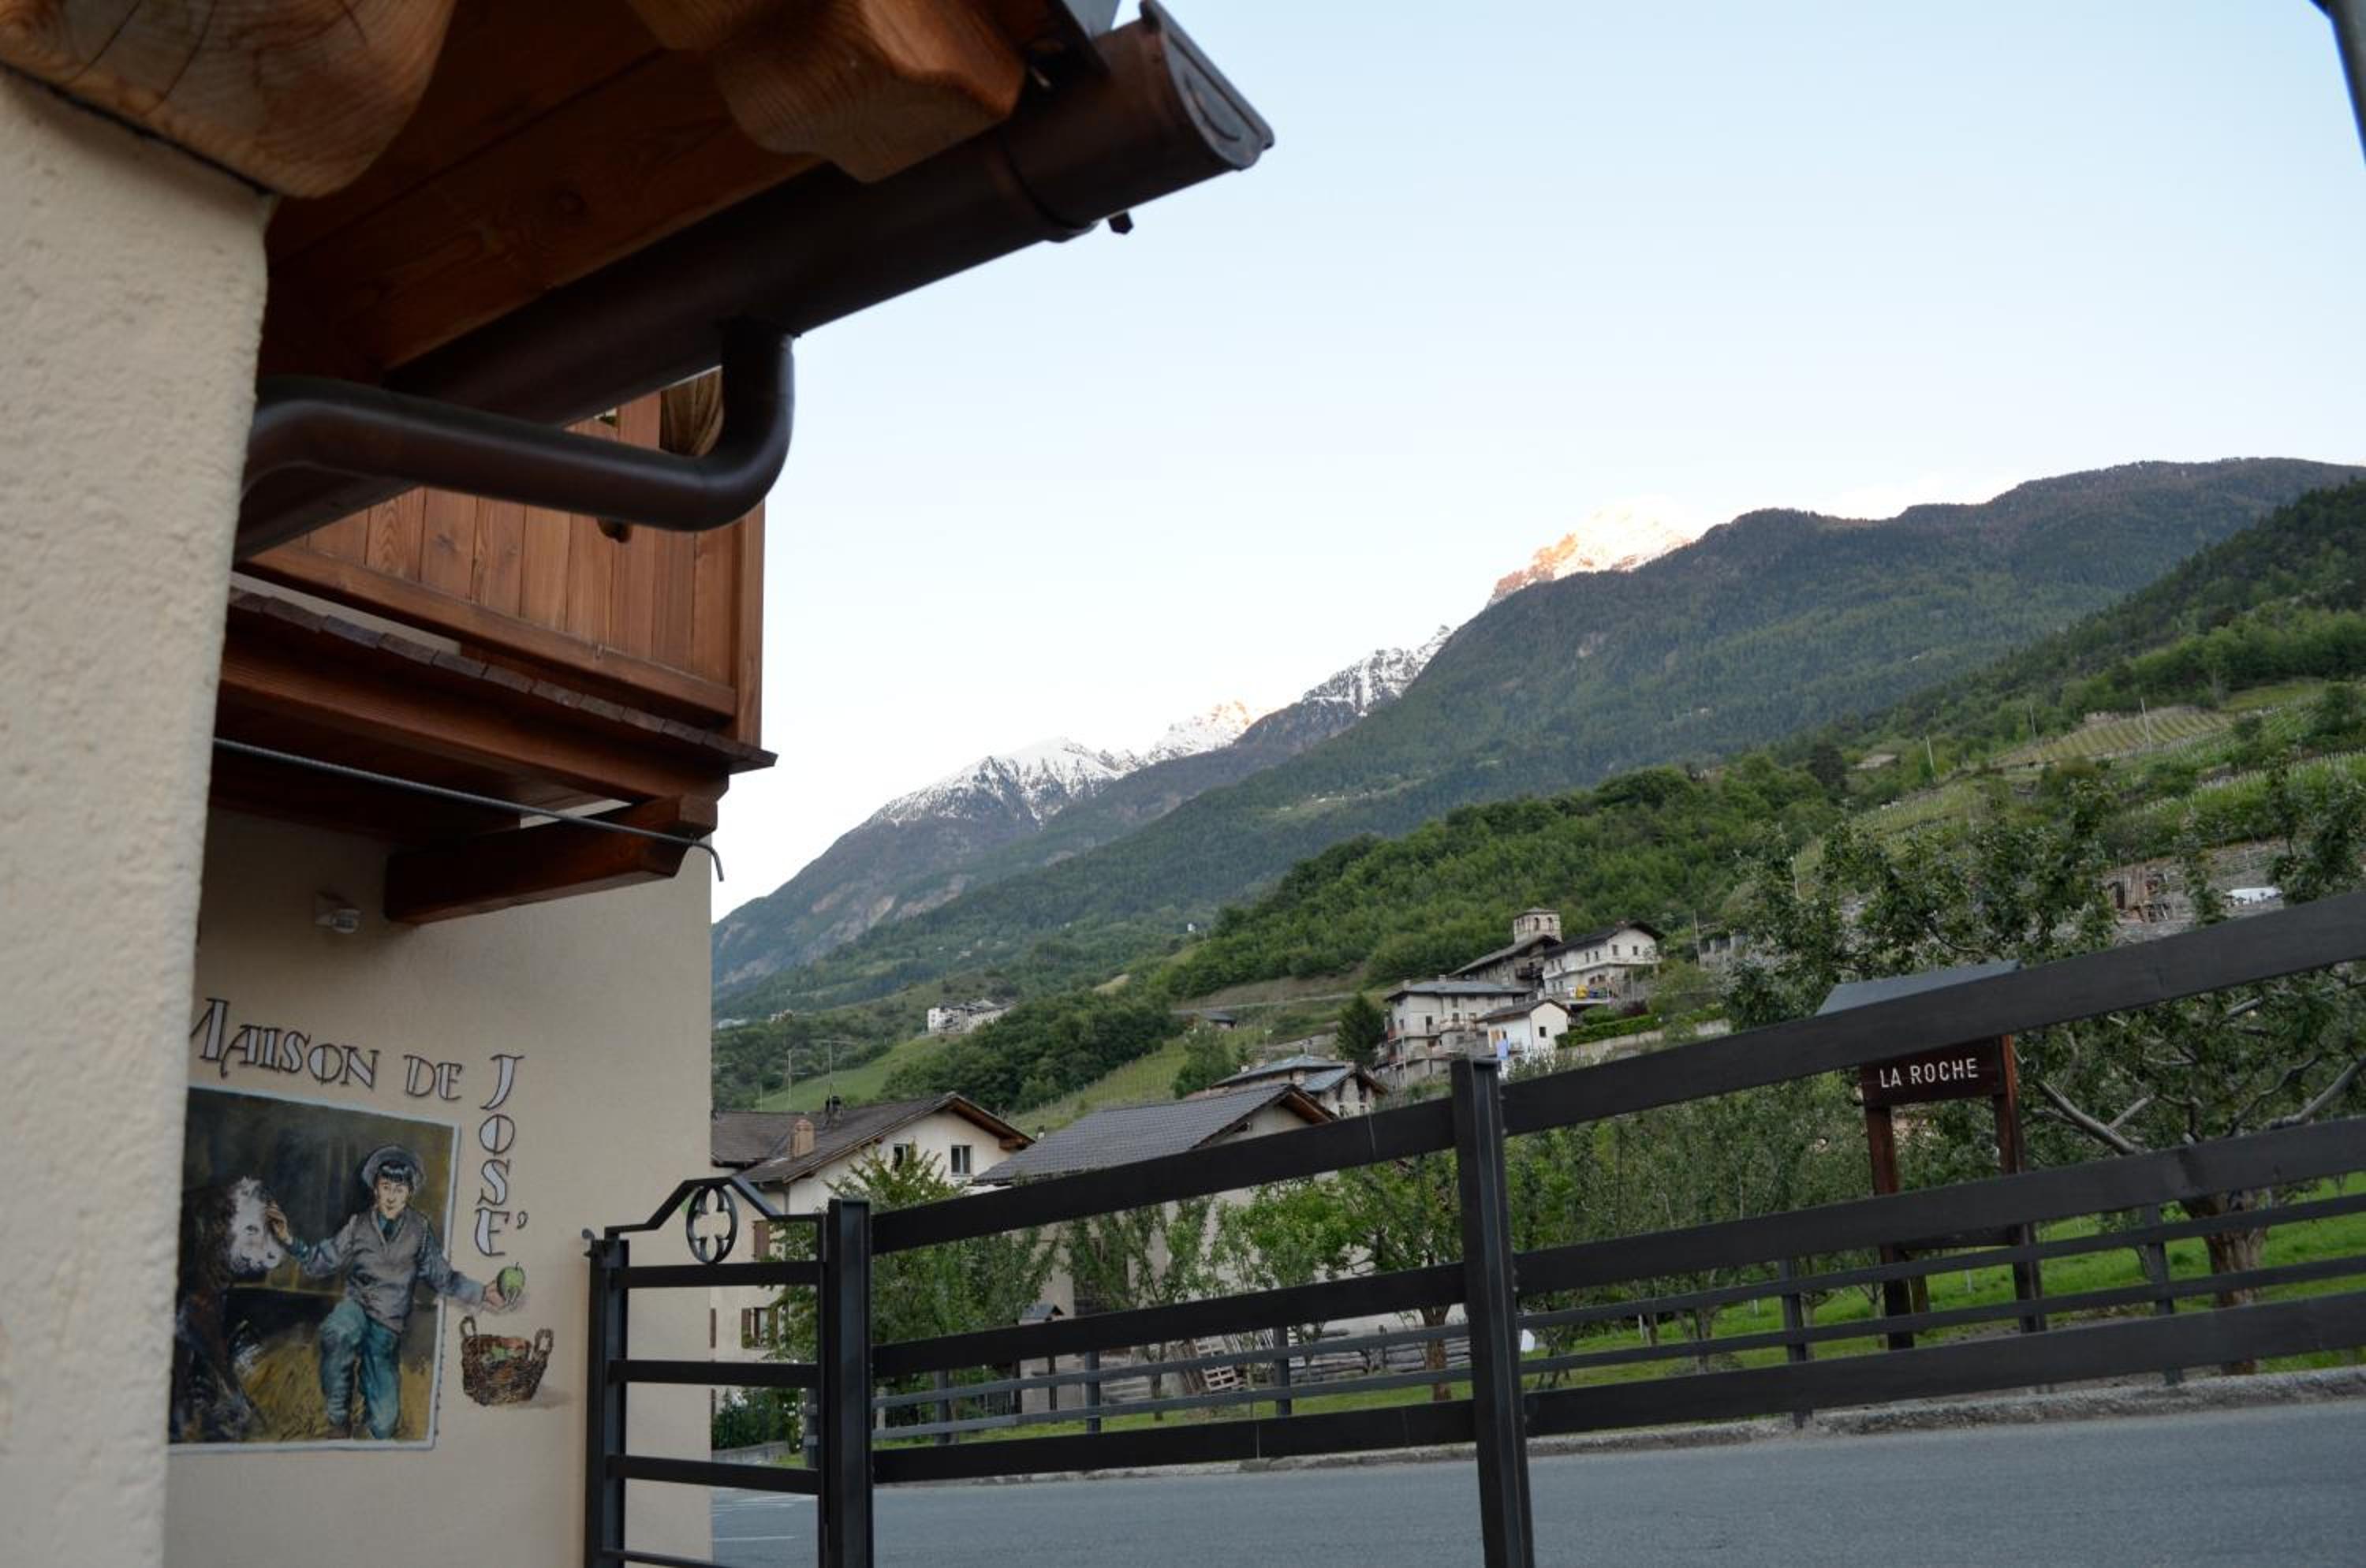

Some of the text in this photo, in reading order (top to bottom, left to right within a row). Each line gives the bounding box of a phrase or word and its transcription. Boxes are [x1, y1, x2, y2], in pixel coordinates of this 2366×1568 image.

[404, 1054, 462, 1100] DE
[1879, 1058, 1979, 1088] LA ROCHE
